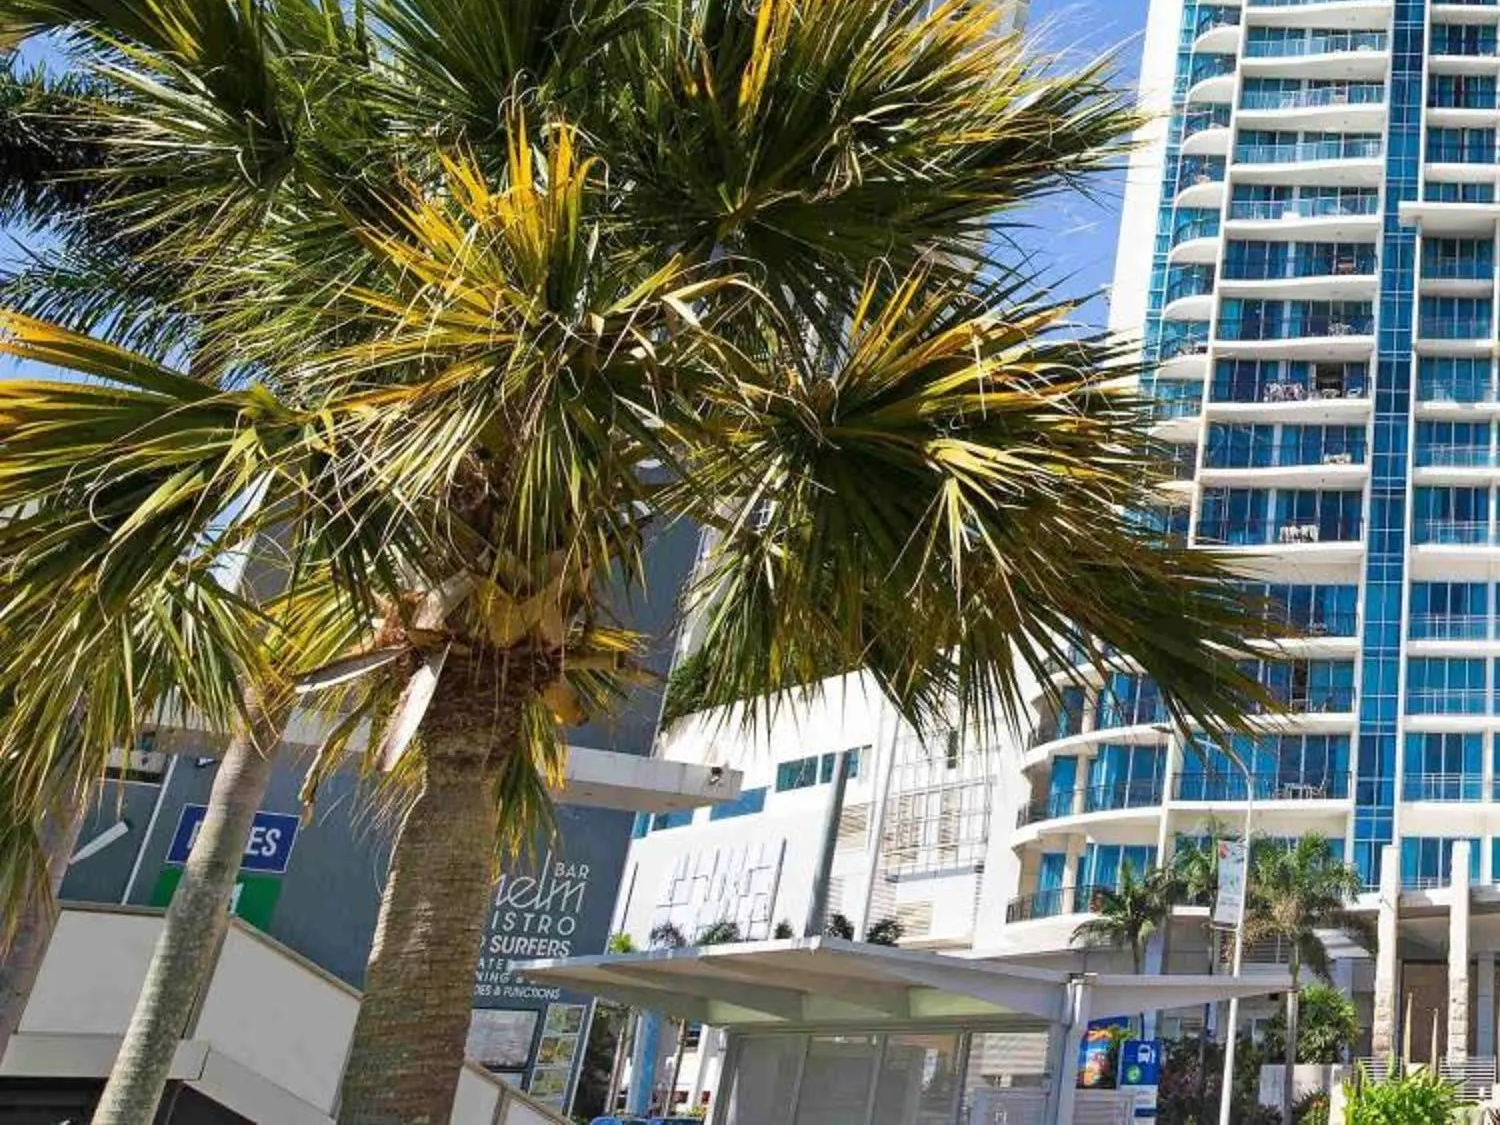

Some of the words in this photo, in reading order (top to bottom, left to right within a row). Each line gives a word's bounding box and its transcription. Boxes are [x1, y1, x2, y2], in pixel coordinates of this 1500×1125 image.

[553, 862, 590, 879] BAR
[491, 910, 576, 935] ISTRO
[488, 934, 572, 957] SURFERS
